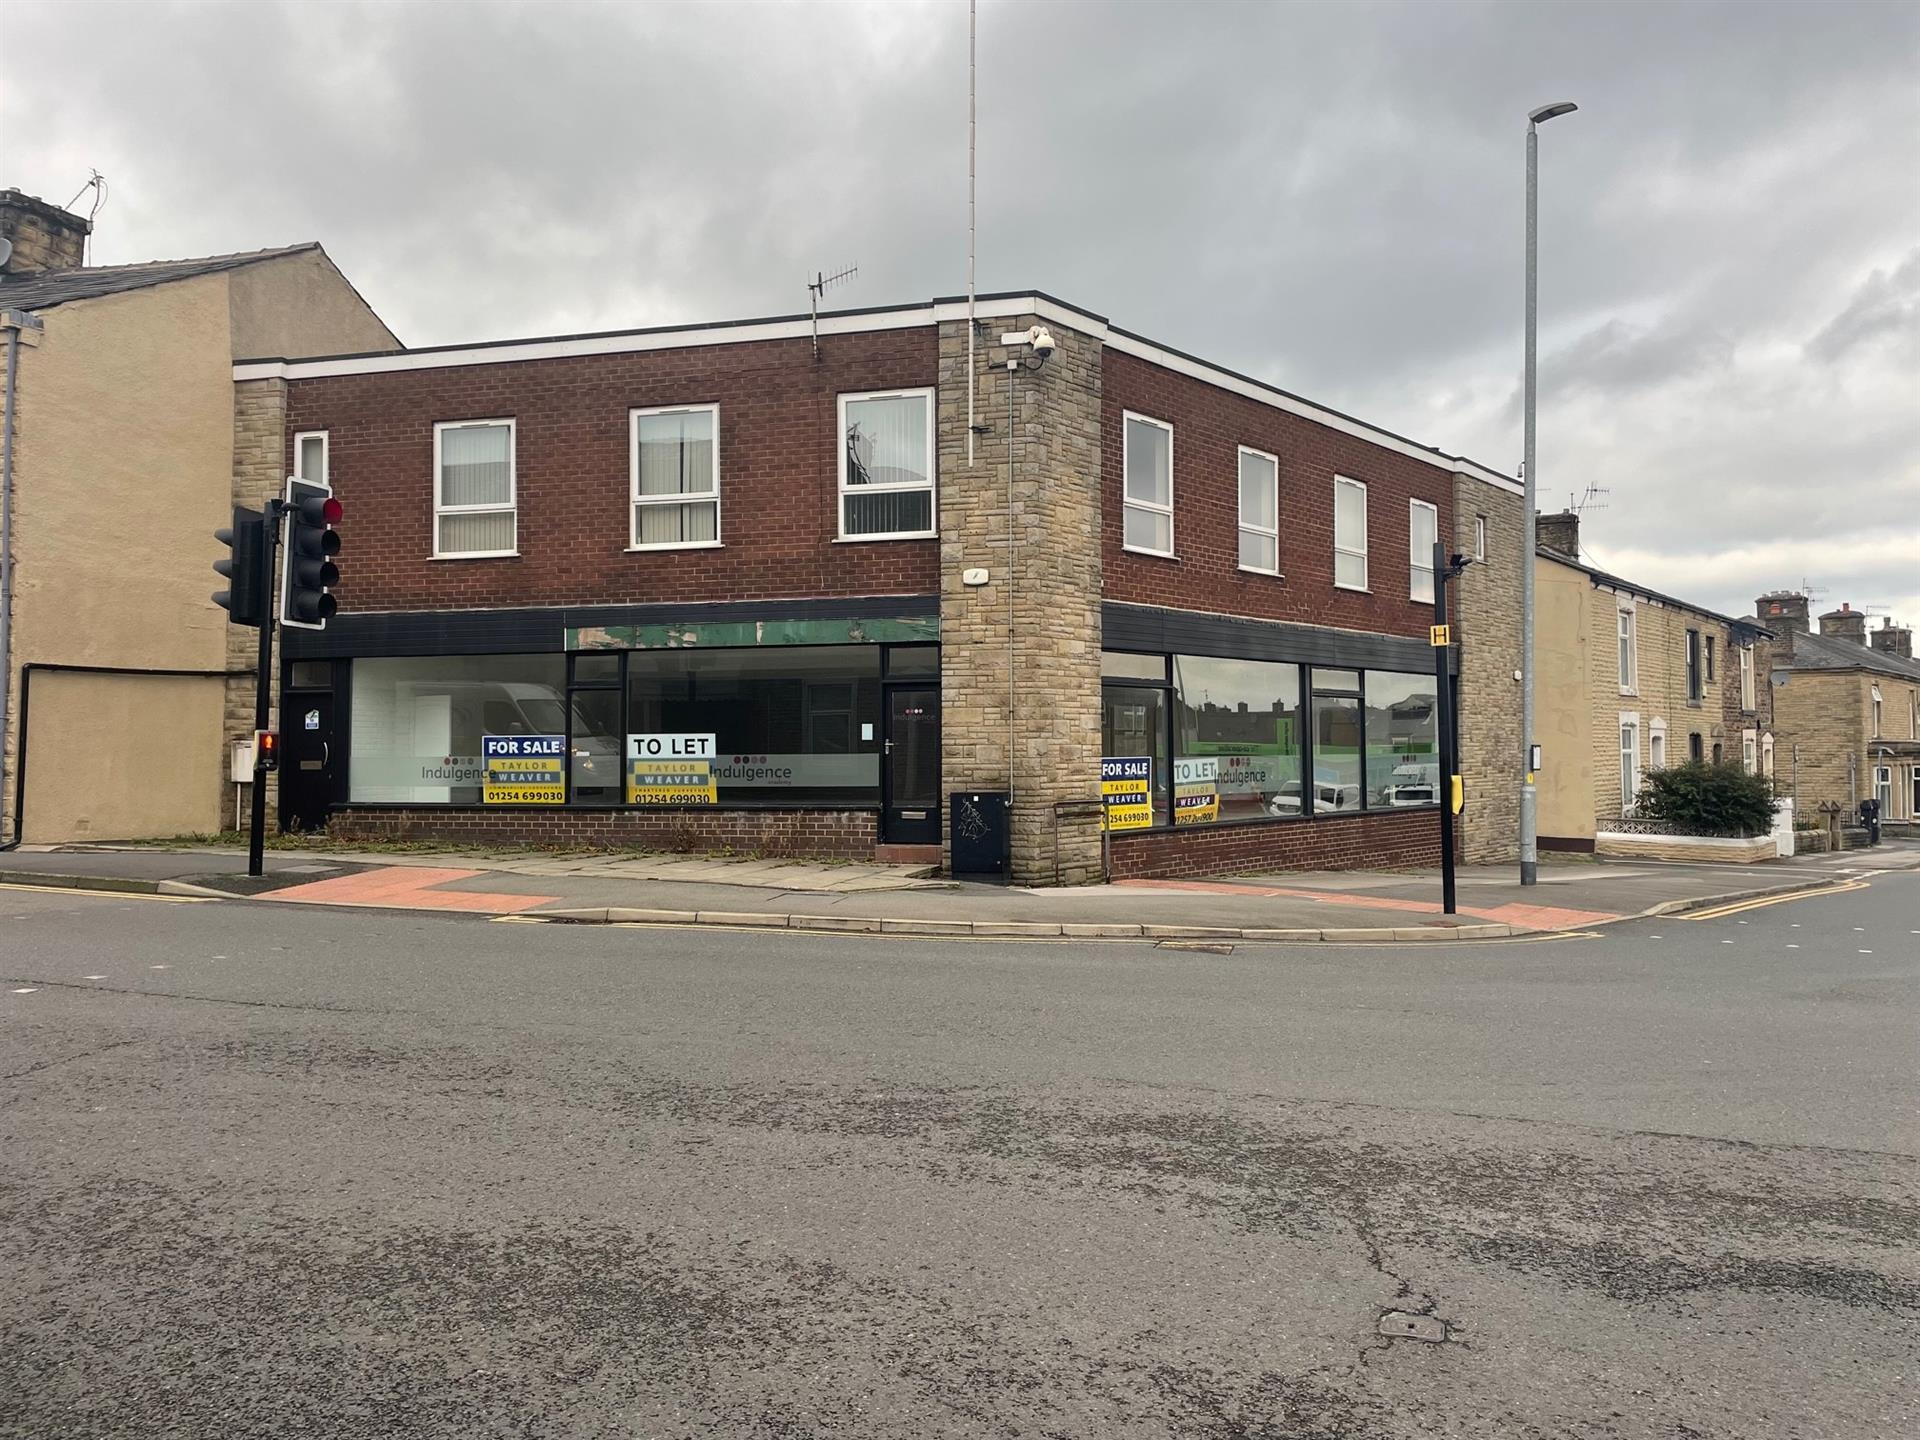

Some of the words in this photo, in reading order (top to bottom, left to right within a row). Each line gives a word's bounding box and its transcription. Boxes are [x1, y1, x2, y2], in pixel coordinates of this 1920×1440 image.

[1433, 626, 1447, 644] H
[488, 741, 519, 754] FOR
[522, 741, 560, 754] SALE
[632, 738, 662, 755] TO
[671, 738, 709, 755] LET
[501, 762, 548, 770] TAYLOR
[647, 764, 696, 773] TAYLOR
[1102, 763, 1122, 776] FOR
[1124, 762, 1148, 775] SALE
[1174, 764, 1191, 779] TO
[1195, 762, 1215, 778] LET
[422, 766, 497, 782] Indulgence
[498, 773, 552, 782] WEAVER
[709, 765, 792, 782] Indulgence
[1214, 767, 1266, 787] Indulgence
[644, 776, 699, 785] WEAVER
[1110, 783, 1140, 792] TAYLOR
[488, 791, 519, 800] 01254
[522, 791, 563, 800] 699030
[635, 794, 668, 804] 01254
[669, 794, 710, 804] 699030
[1108, 794, 1142, 804] WEAVER
[1180, 796, 1211, 807] WEAVER
